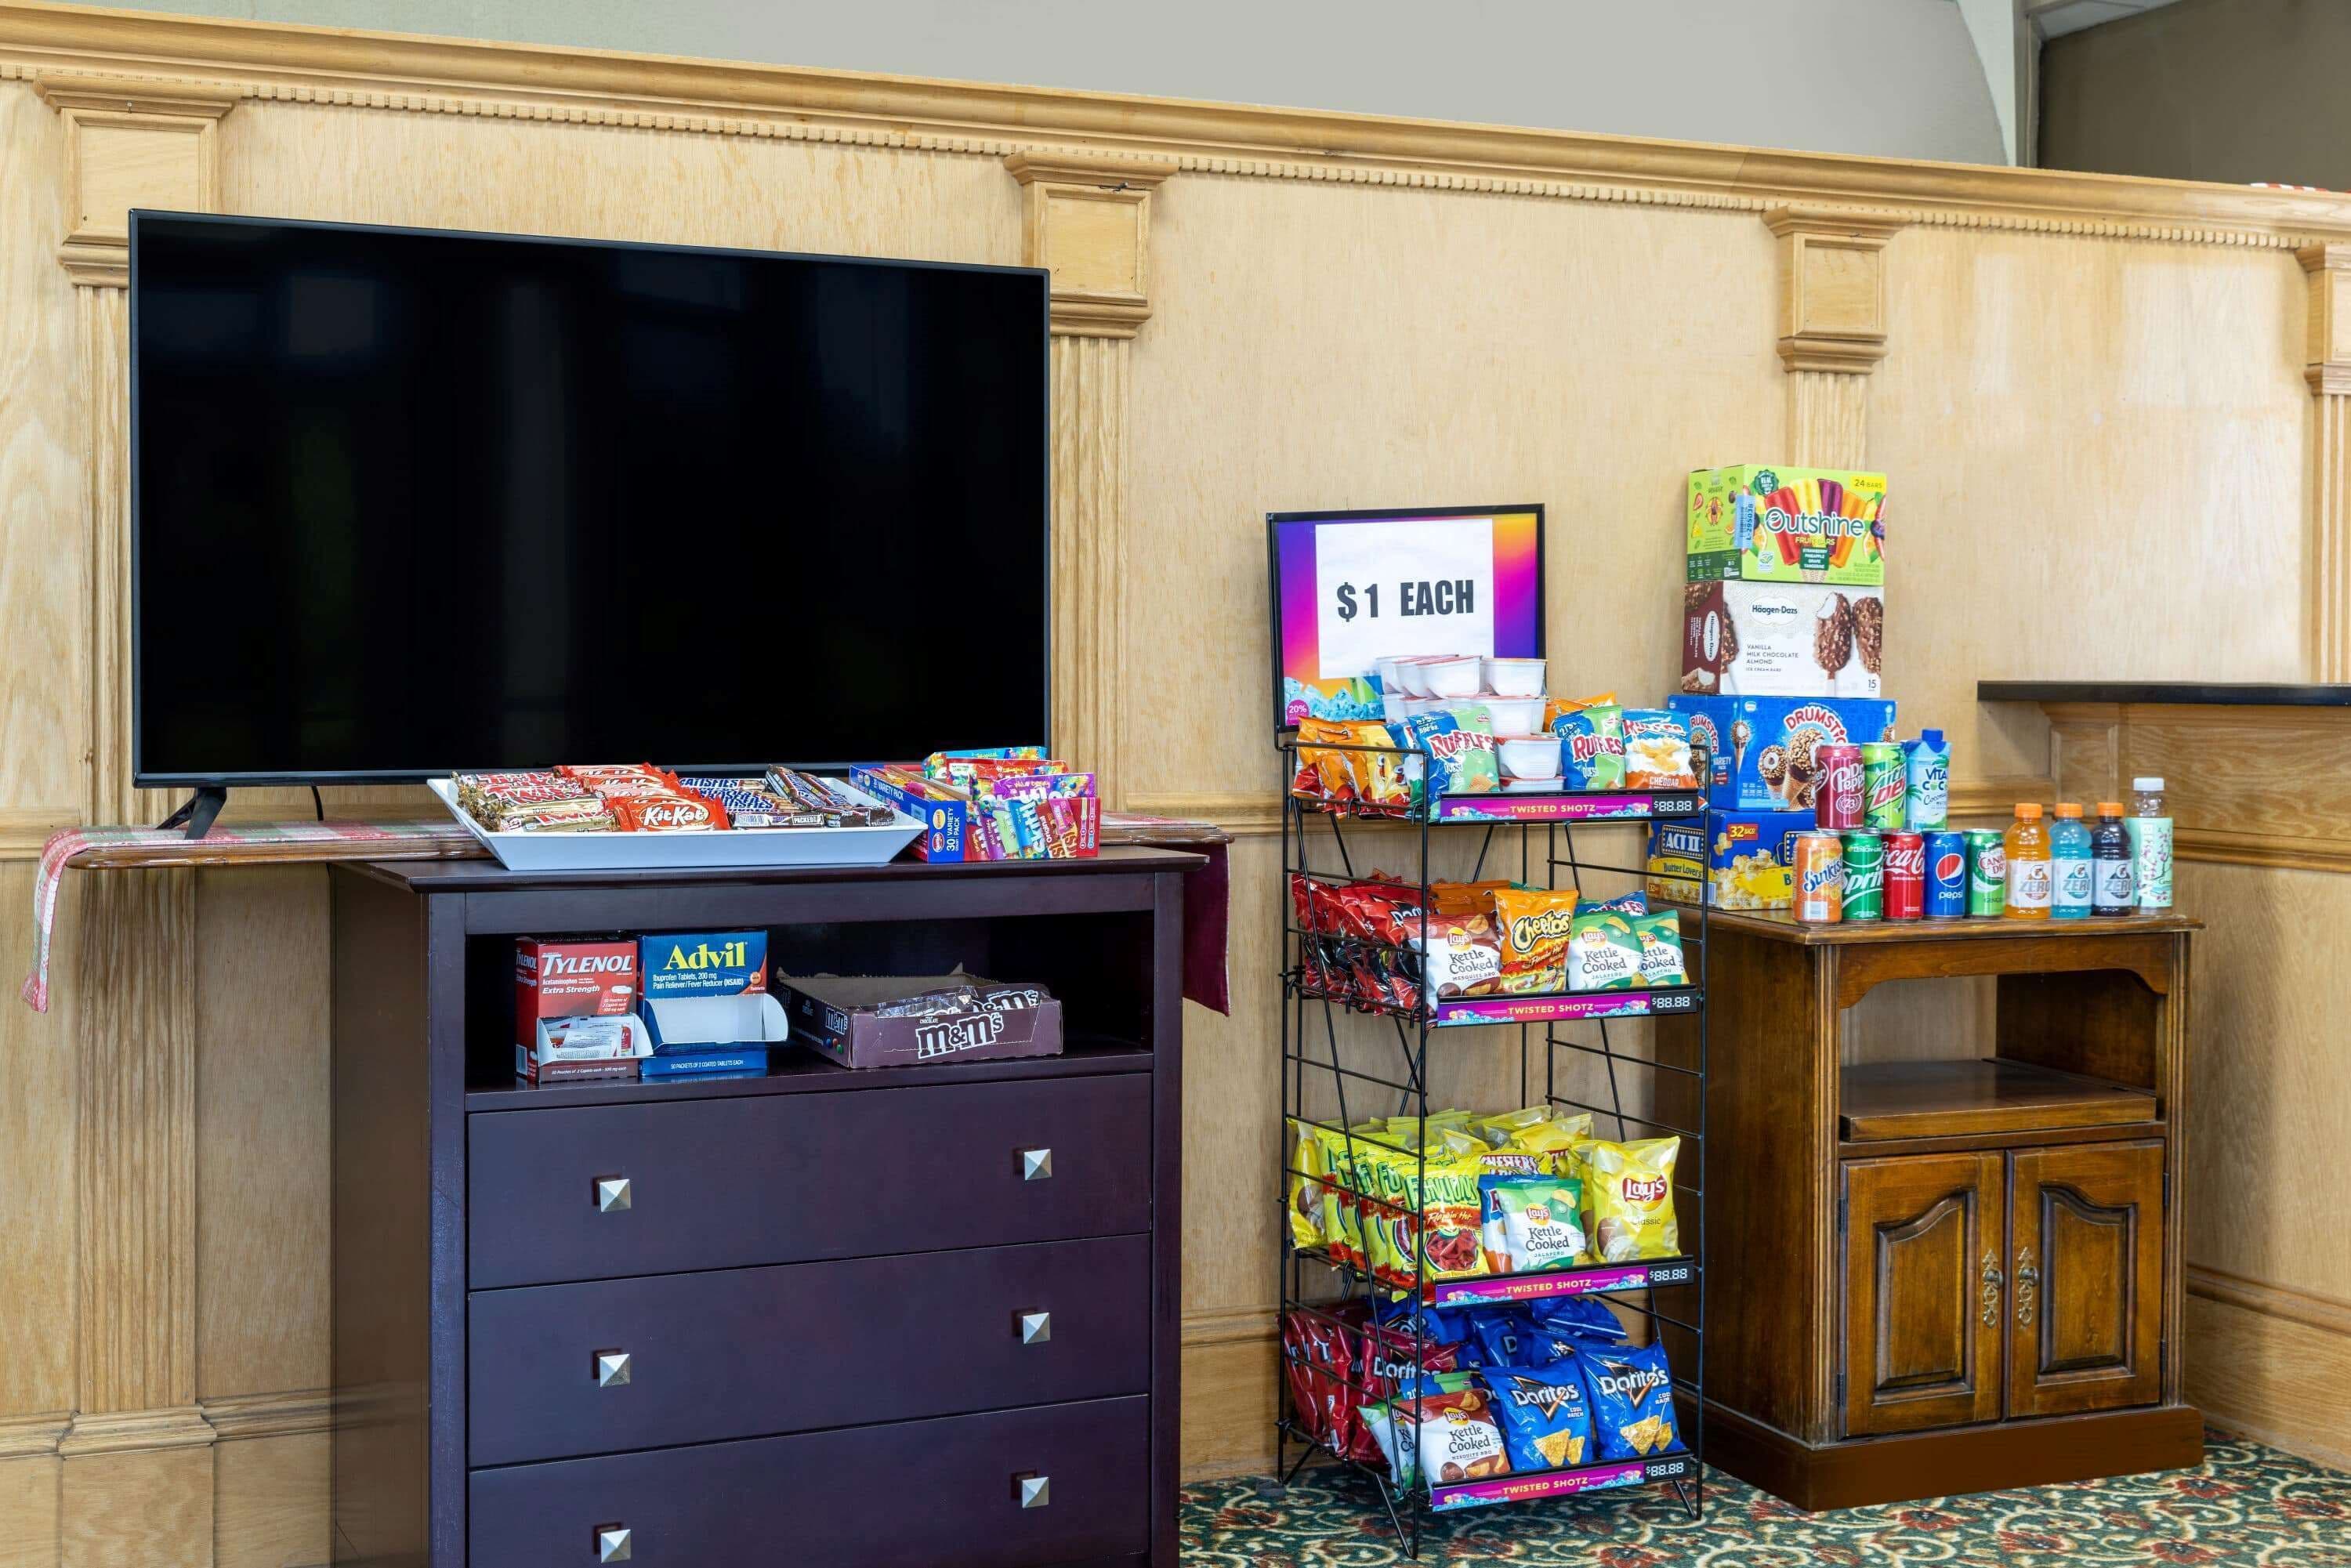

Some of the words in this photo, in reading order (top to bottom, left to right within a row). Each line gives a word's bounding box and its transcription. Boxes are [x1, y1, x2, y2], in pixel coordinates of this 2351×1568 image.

[1766, 509, 1864, 536] Outshine
[1400, 579, 1474, 616] EACH
[1867, 679, 1877, 688] 15
[1288, 704, 1307, 713] 20%
[1649, 777, 1679, 786] CHEDDAR
[1925, 768, 1947, 780] VITA
[1560, 803, 1596, 813] SHOTZ
[1654, 801, 1692, 812] $88.88
[1730, 826, 1744, 838] 32
[946, 838, 955, 851] 30
[1665, 833, 1686, 851] ACT
[1687, 835, 1699, 852] II
[1664, 863, 1681, 873] Butter
[1939, 890, 1963, 900] pepsi
[1512, 910, 1571, 952] Cheetos
[662, 942, 745, 970] Advil
[1449, 950, 1485, 965] Kettle
[1585, 949, 1619, 964] Kettle
[1642, 947, 1668, 961] ettle
[541, 954, 632, 977] TYLENOL
[1449, 959, 1494, 975] Cooked
[1582, 958, 1627, 974] Cooked
[566, 985, 600, 994] Strength
[723, 978, 744, 987] (NSAID)
[1559, 1004, 1594, 1012] SHOTZ
[1652, 996, 1690, 1009] $88.88
[825, 1008, 848, 1035] m&m's
[916, 1012, 1004, 1059] m&m's
[1625, 1175, 1666, 1201] Lay's
[1631, 1216, 1661, 1226] Classic
[1529, 1226, 1562, 1243] Kettle
[1526, 1236, 1570, 1252] Cooked
[1556, 1279, 1592, 1289] SHOTZ
[1649, 1268, 1687, 1282] $88.88
[1599, 1367, 1668, 1395] Doritos
[1511, 1383, 1580, 1406] Doritos
[1450, 1425, 1483, 1442] Kettle
[1448, 1436, 1490, 1454] Cooked
[1553, 1477, 1588, 1487] SHOTZ
[1646, 1462, 1684, 1476] $88.88
